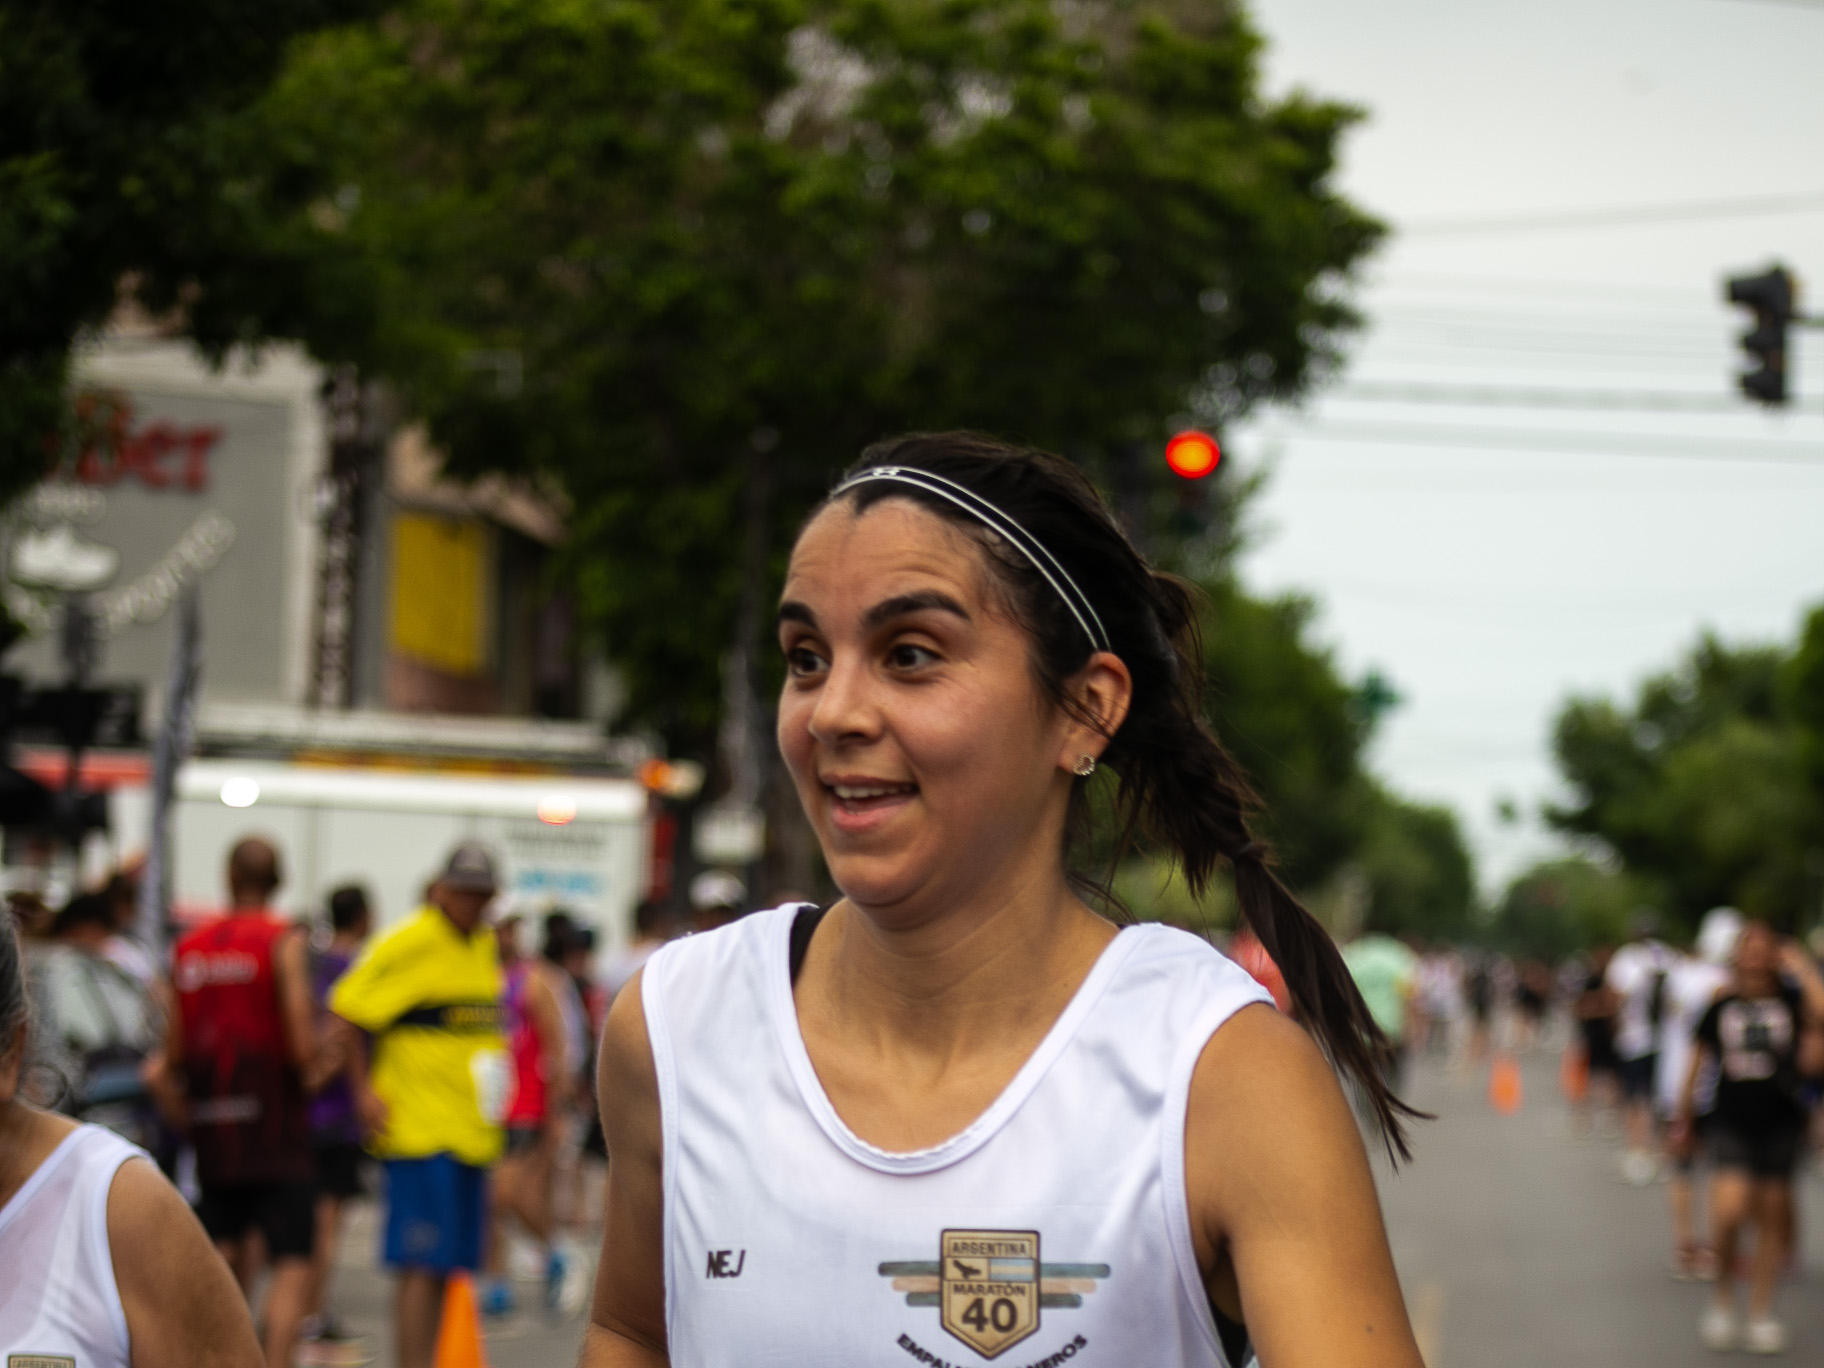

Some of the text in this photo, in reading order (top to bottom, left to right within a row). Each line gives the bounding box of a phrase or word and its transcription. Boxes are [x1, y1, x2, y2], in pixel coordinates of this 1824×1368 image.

[952, 1241, 1026, 1256] ARGENTINA
[706, 1249, 746, 1279] NEJ
[962, 1298, 1018, 1333] 40
